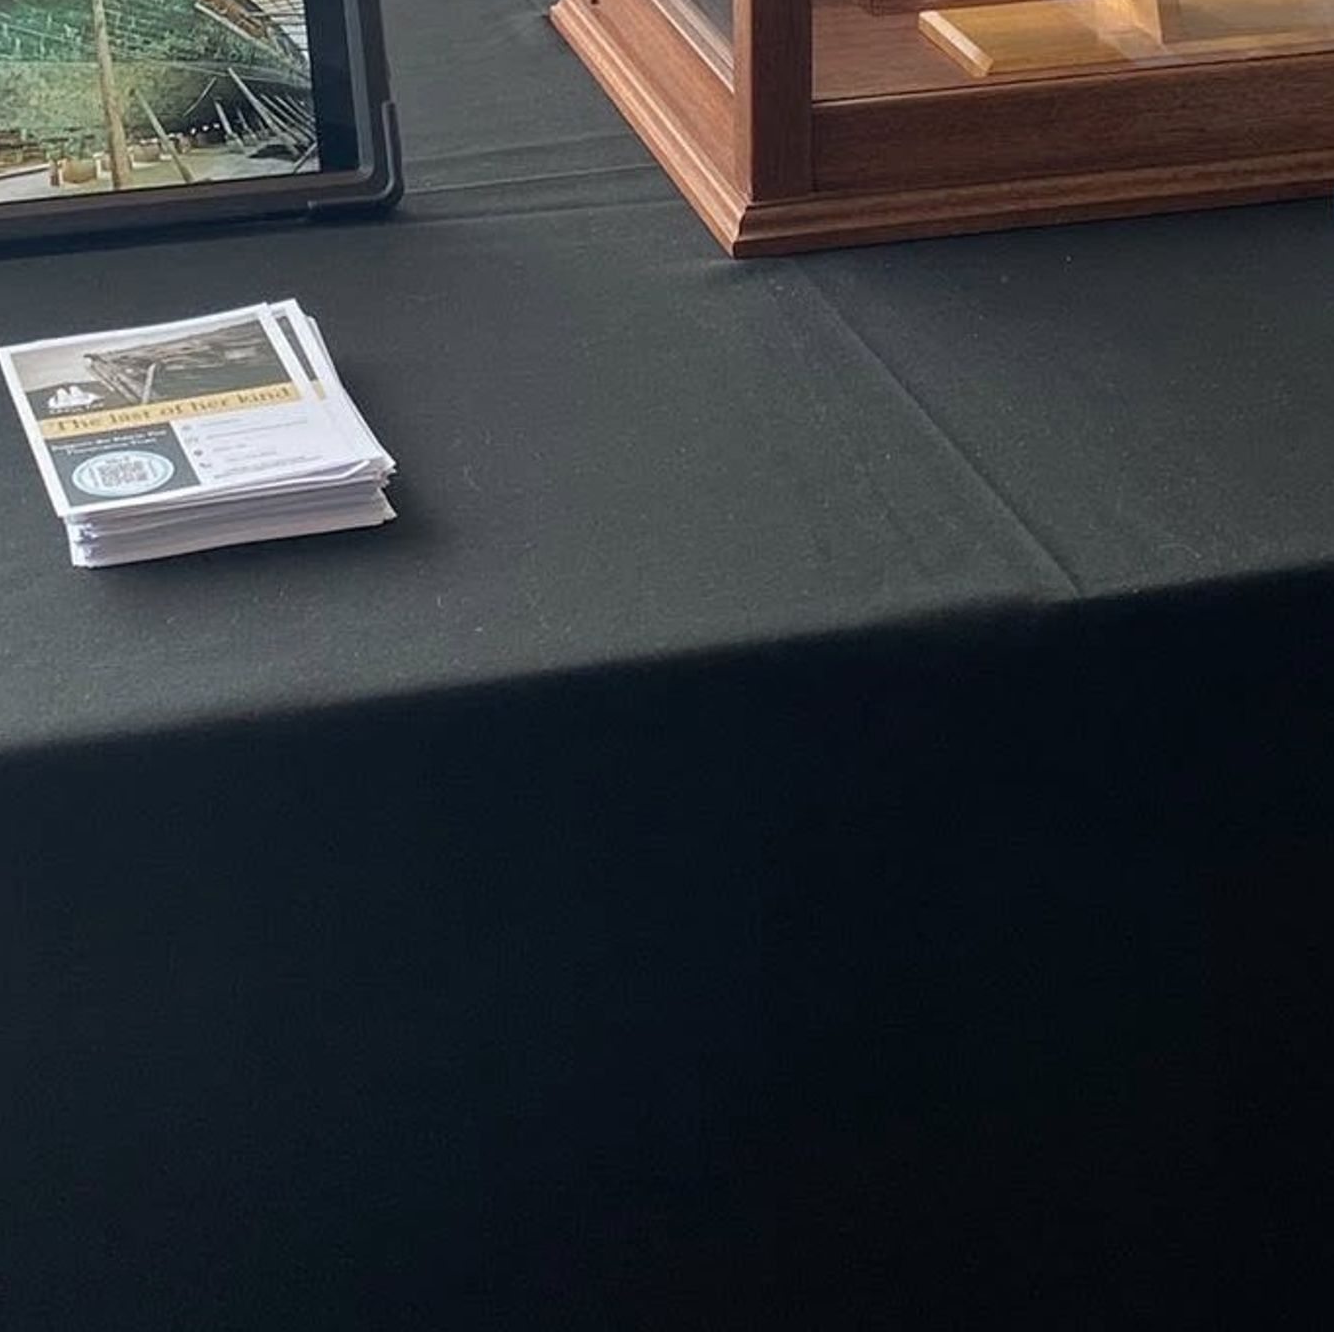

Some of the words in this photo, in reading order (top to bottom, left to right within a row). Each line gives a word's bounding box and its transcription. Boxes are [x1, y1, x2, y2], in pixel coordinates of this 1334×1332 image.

[48, 416, 104, 433] The
[108, 408, 151, 427] last
[159, 403, 183, 416] of
[189, 398, 228, 414] her
[235, 386, 293, 406] kind
